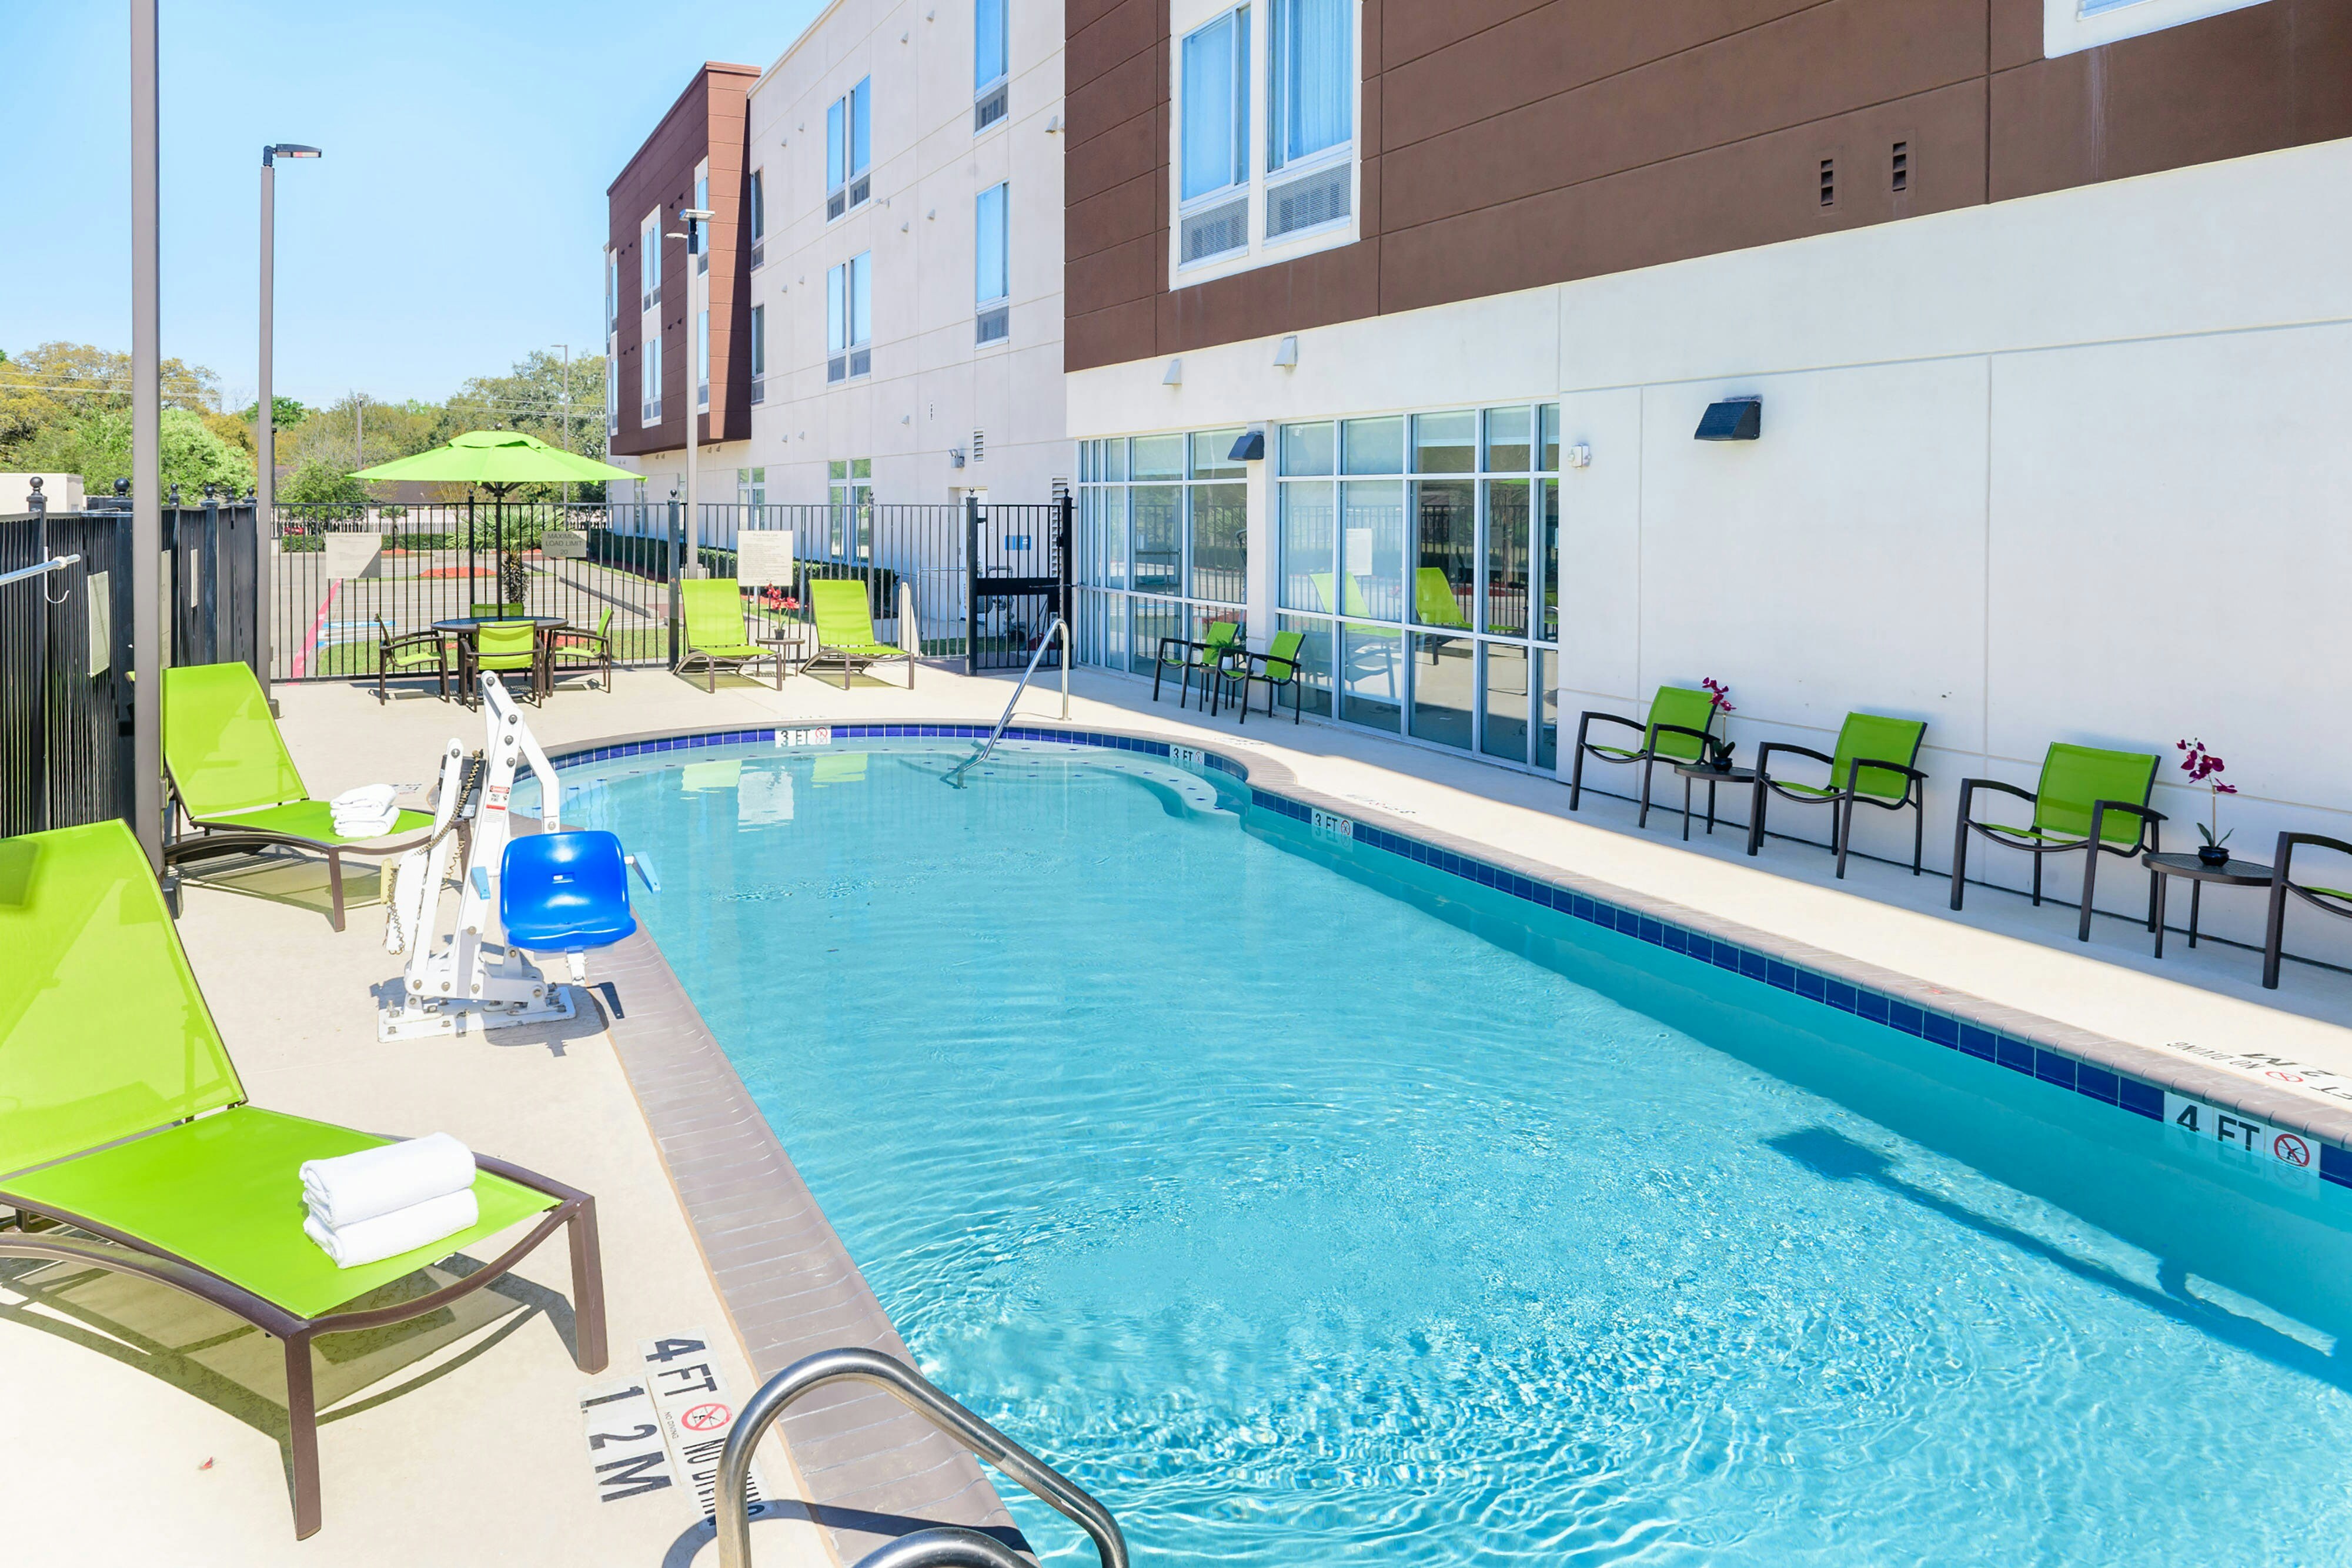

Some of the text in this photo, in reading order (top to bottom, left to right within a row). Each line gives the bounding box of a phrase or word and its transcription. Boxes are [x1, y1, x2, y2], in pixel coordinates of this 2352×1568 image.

[780, 730, 789, 740] 3
[1174, 747, 1193, 761] 3 FT
[1315, 813, 1338, 832] 3 FT
[2166, 1041, 2234, 1060] DIVING
[2176, 1105, 2260, 1151] 4 FT
[667, 1420, 679, 1439] DIVING
